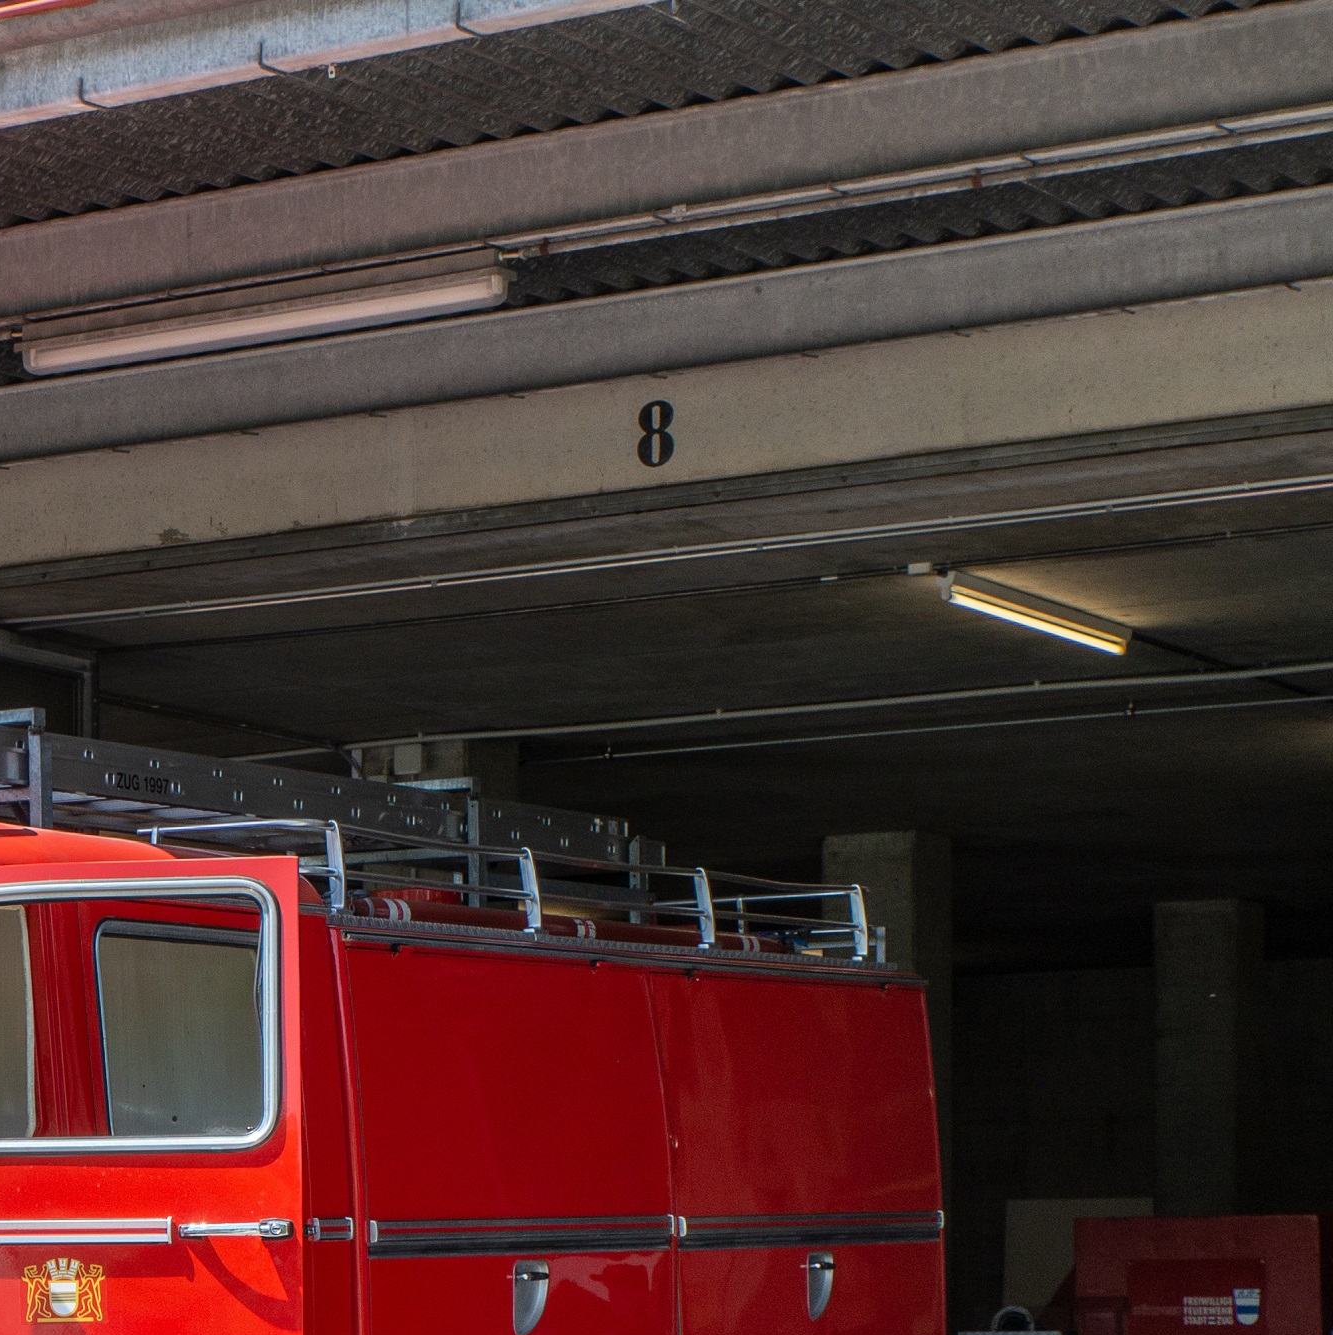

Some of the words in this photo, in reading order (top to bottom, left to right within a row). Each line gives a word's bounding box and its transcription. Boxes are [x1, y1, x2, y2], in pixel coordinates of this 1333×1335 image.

[636, 400, 674, 467] 8
[116, 772, 140, 791] ZUG
[144, 776, 169, 794] 1997
